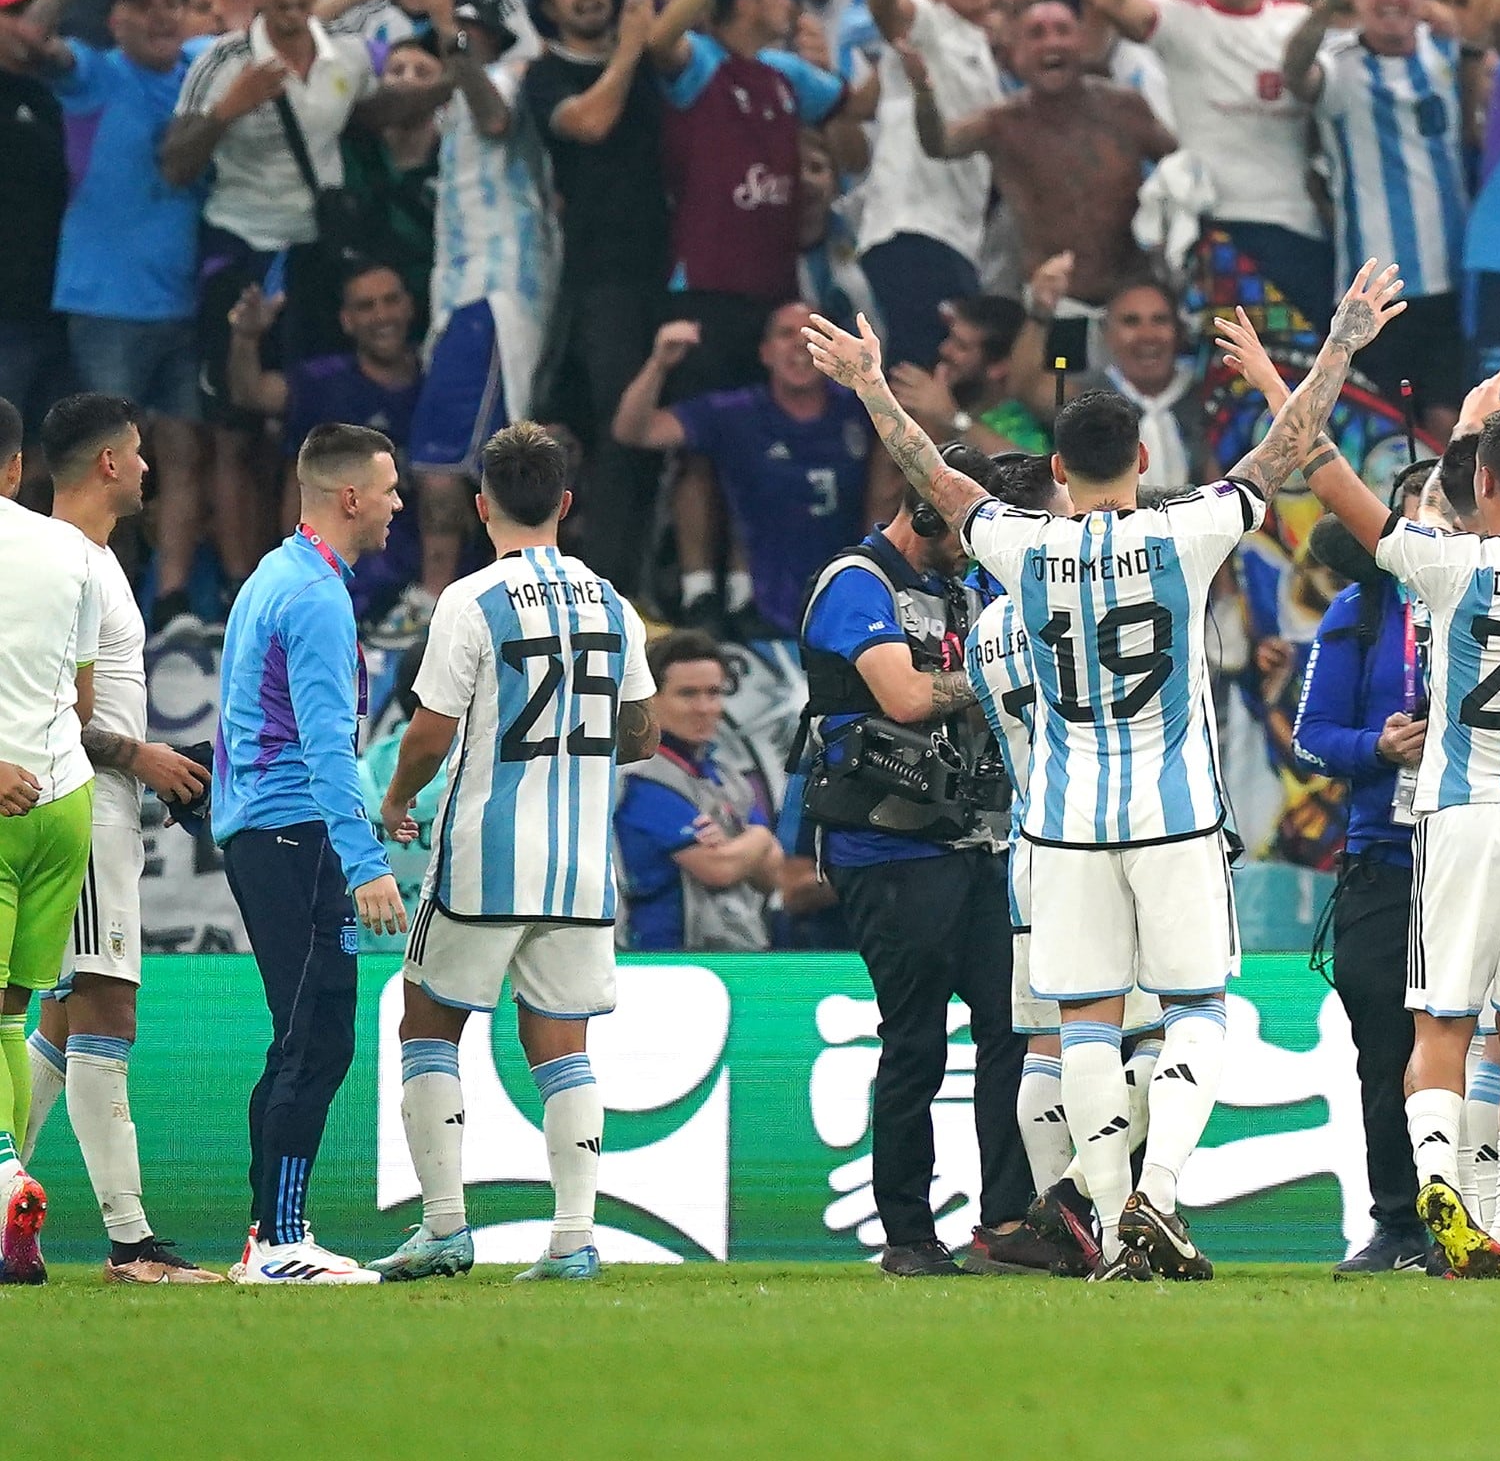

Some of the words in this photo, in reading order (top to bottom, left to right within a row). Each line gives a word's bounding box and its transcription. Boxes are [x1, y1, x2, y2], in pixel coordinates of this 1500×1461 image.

[505, 578, 610, 611] MARTINEZ
[1031, 544, 1165, 584] OTAMENDI
[499, 632, 623, 764] 25
[1039, 602, 1173, 724] 19
